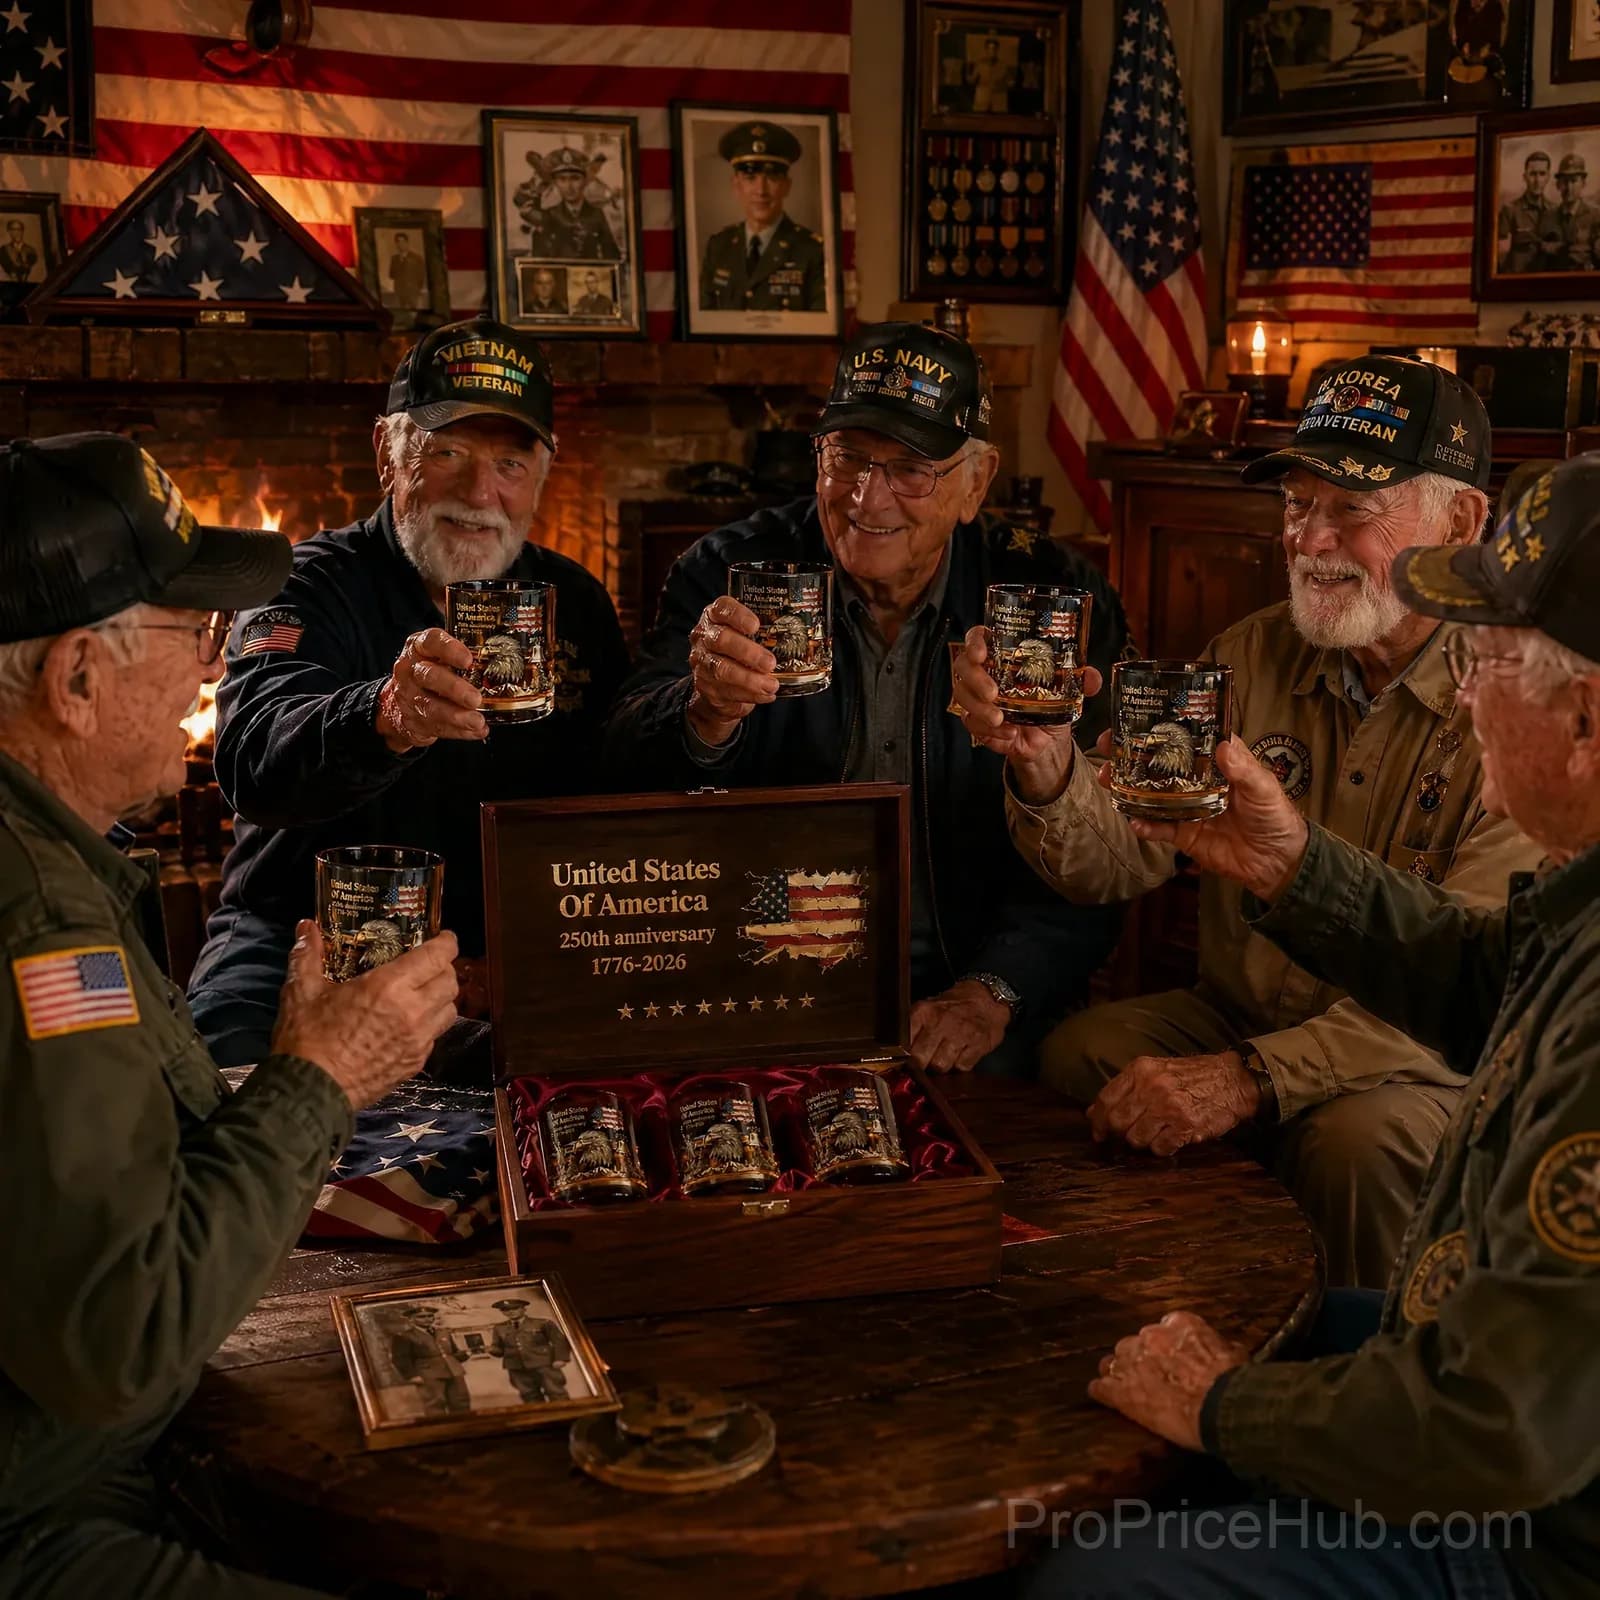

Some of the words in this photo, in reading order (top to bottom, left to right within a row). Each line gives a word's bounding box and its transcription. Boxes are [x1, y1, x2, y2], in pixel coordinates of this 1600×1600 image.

[440, 340, 535, 375] VIETNAM
[854, 348, 888, 369] U.S.
[894, 349, 952, 384] NAVY
[452, 375, 523, 398] VETERAN
[1334, 370, 1401, 401] KOREA
[552, 860, 638, 888] United
[644, 858, 721, 883] States
[559, 893, 593, 918] Of
[598, 890, 709, 917] America
[559, 929, 611, 949] 250th
[614, 926, 717, 945] anniversary
[592, 953, 687, 975] 1776-2026
